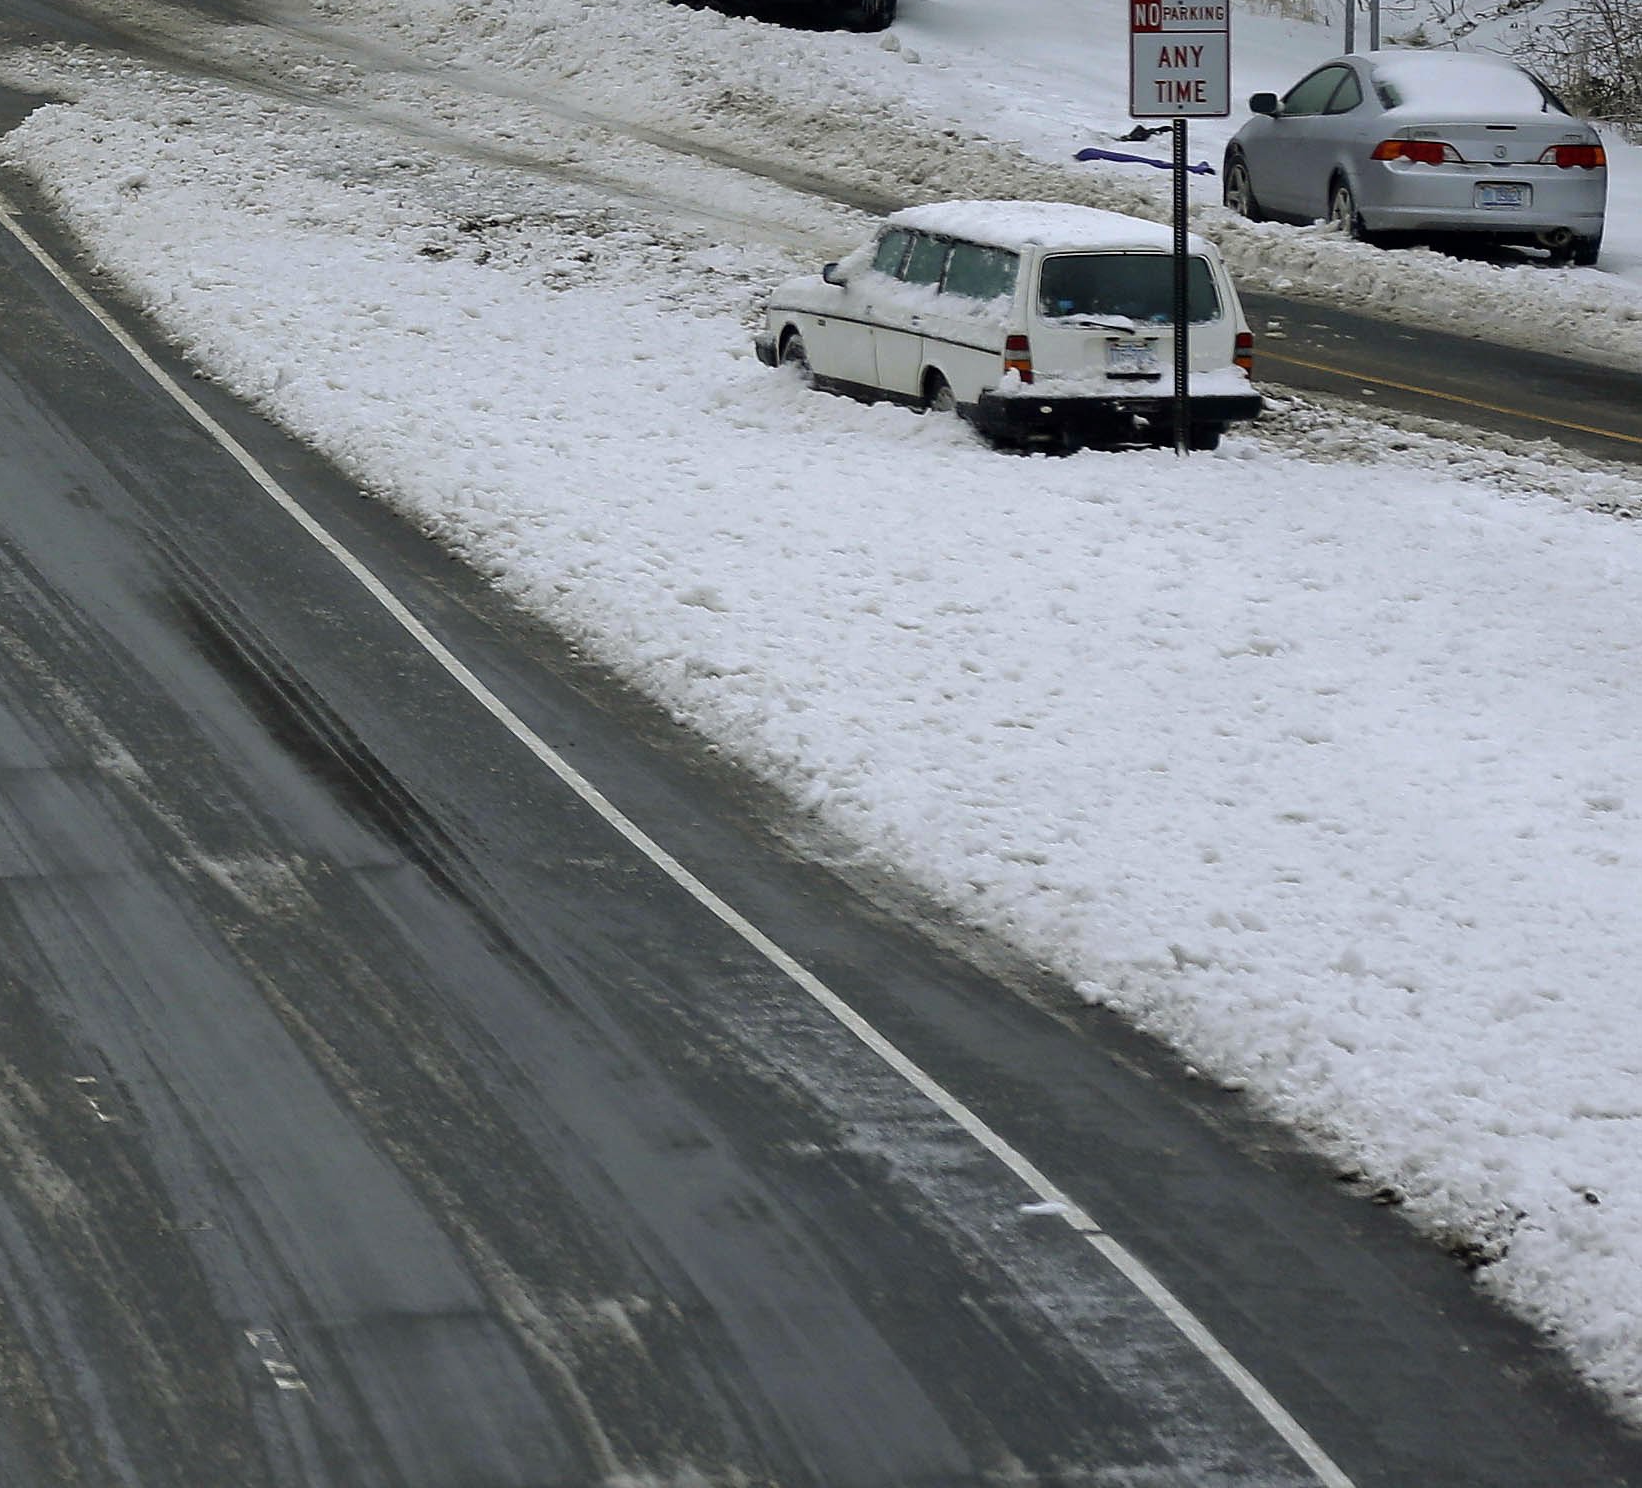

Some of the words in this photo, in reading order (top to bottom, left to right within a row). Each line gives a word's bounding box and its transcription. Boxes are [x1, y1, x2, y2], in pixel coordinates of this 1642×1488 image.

[1135, 3, 1160, 26] NO
[1162, 6, 1225, 20] PARKING
[1158, 45, 1204, 68] ANY
[1154, 79, 1207, 103] TIME
